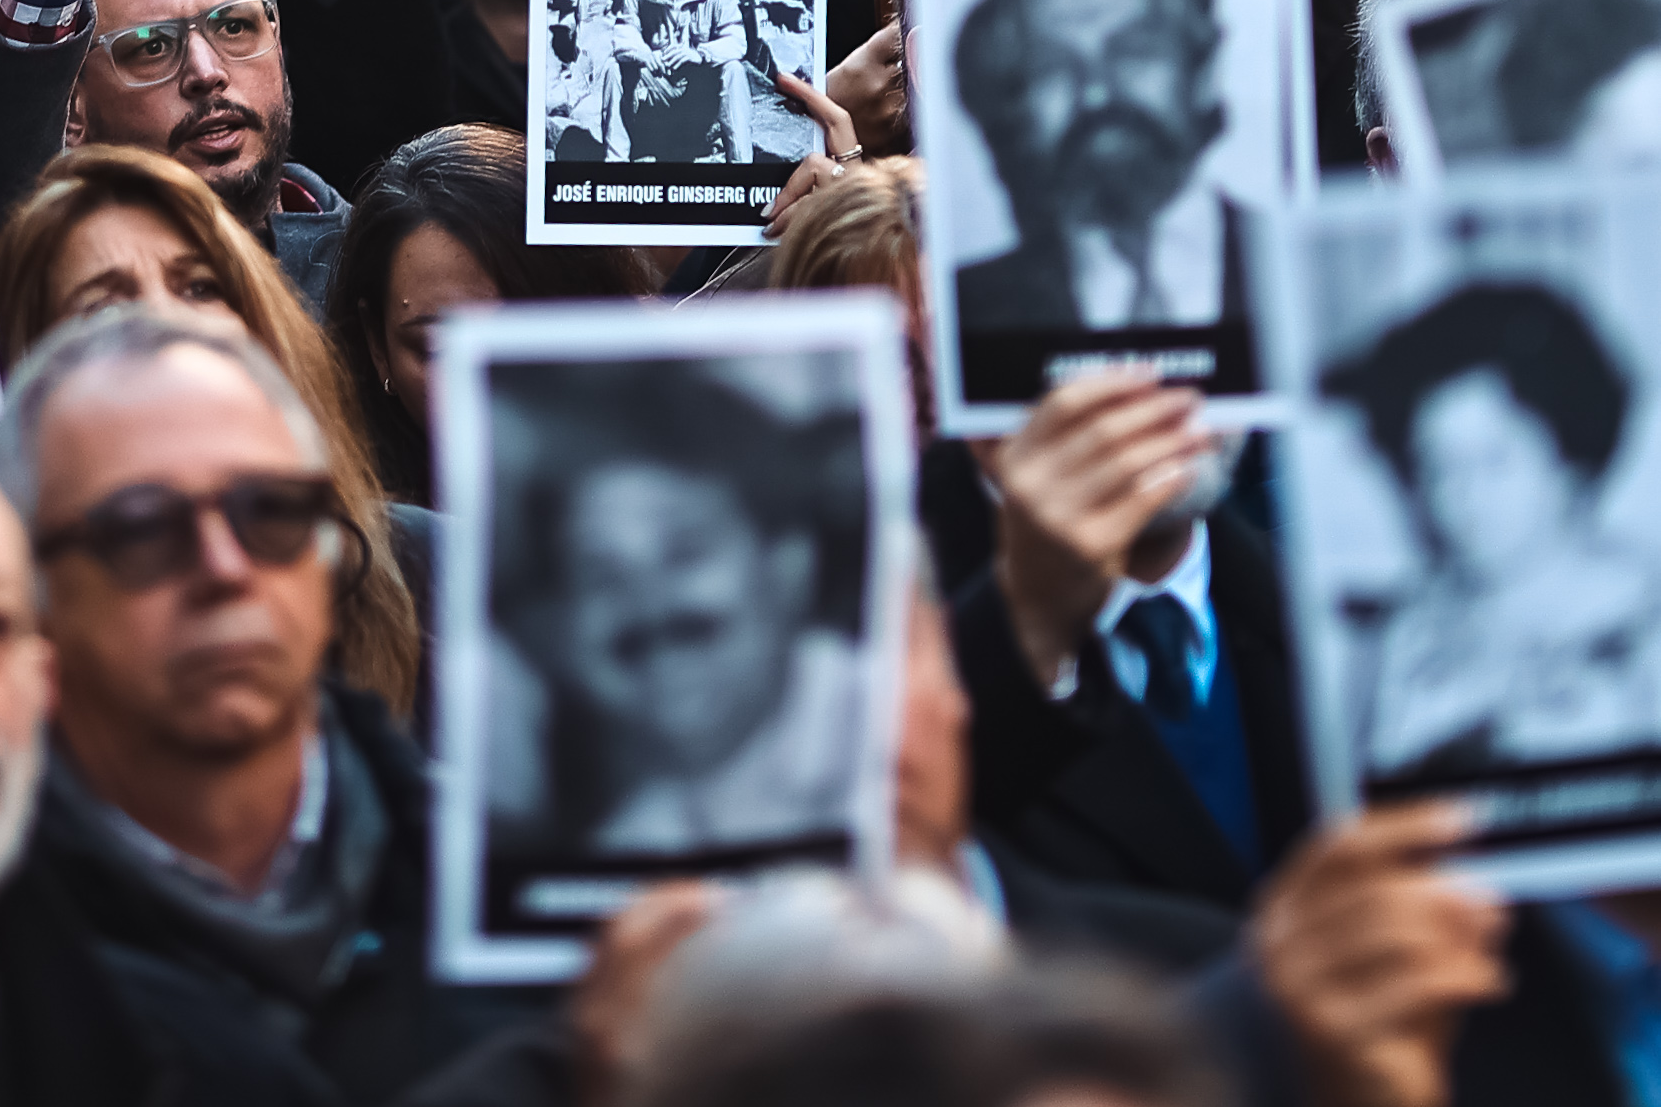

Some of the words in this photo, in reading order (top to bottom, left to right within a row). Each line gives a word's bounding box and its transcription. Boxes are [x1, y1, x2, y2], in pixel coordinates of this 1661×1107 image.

[552, 180, 592, 203] JOSÉ
[596, 184, 664, 205] ENRIQUE
[668, 186, 746, 204] GINSBERG
[750, 186, 782, 208] (KU
